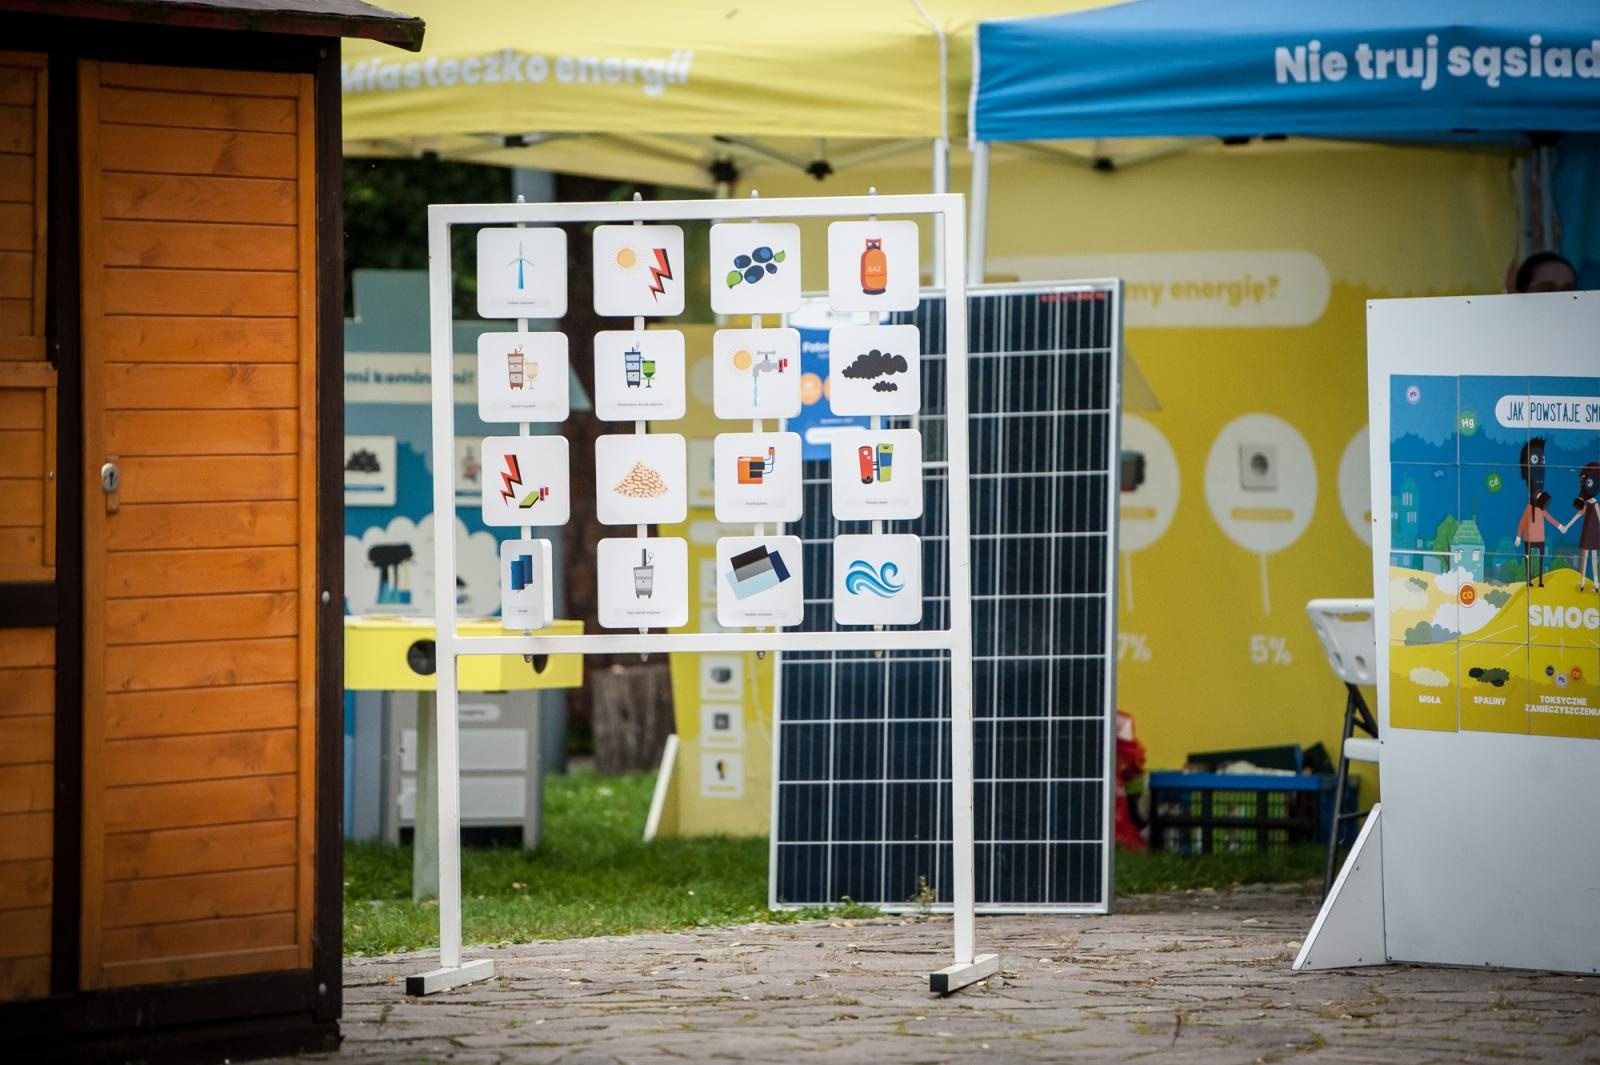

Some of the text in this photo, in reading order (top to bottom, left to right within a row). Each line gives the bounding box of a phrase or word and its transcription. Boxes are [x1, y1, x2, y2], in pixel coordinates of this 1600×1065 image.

[341, 47, 694, 97] Miasteczko energii
[1275, 34, 1600, 91] Nie truj sąsiad
[1461, 417, 1475, 429] Hg
[1506, 401, 1524, 421] JAK
[1530, 402, 1581, 423] POWSTAJE
[1462, 591, 1474, 601] CO
[1528, 604, 1600, 630] SMOG
[1250, 634, 1293, 666] 5%
[1473, 695, 1507, 706] SPALINY
[1539, 694, 1588, 706] TOKSYCZNE
